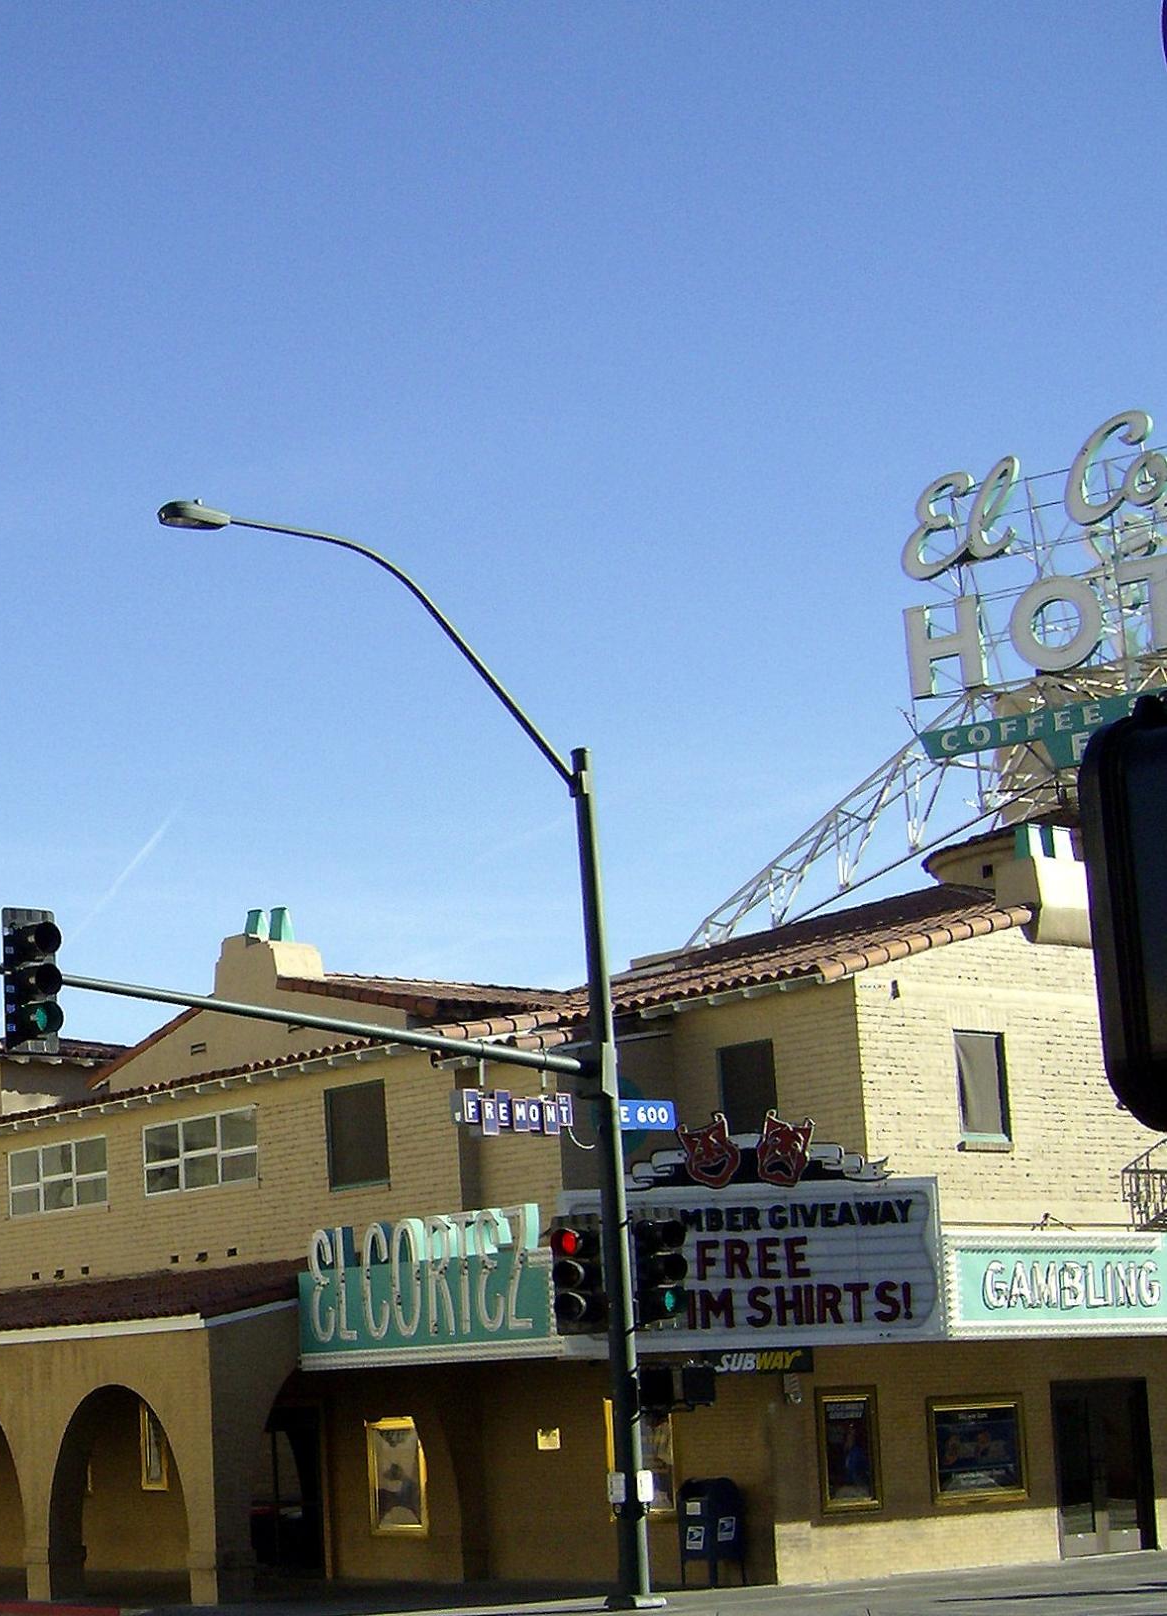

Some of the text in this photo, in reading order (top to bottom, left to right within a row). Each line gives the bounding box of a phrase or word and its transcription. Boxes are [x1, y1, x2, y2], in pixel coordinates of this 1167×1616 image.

[901, 455, 1020, 581] El
[941, 703, 1104, 752] COFFEE
[467, 1101, 568, 1123] FREMONT
[620, 1106, 669, 1123] E 600
[682, 1199, 913, 1232] MBER GIVEAWAY
[308, 1204, 536, 1342] EL CORTEZ
[696, 1236, 811, 1281] FREE
[688, 1280, 913, 1330] IM SHIRTS!
[983, 1259, 1162, 1311] GAMBLING
[714, 1350, 801, 1372] SUBWAY
